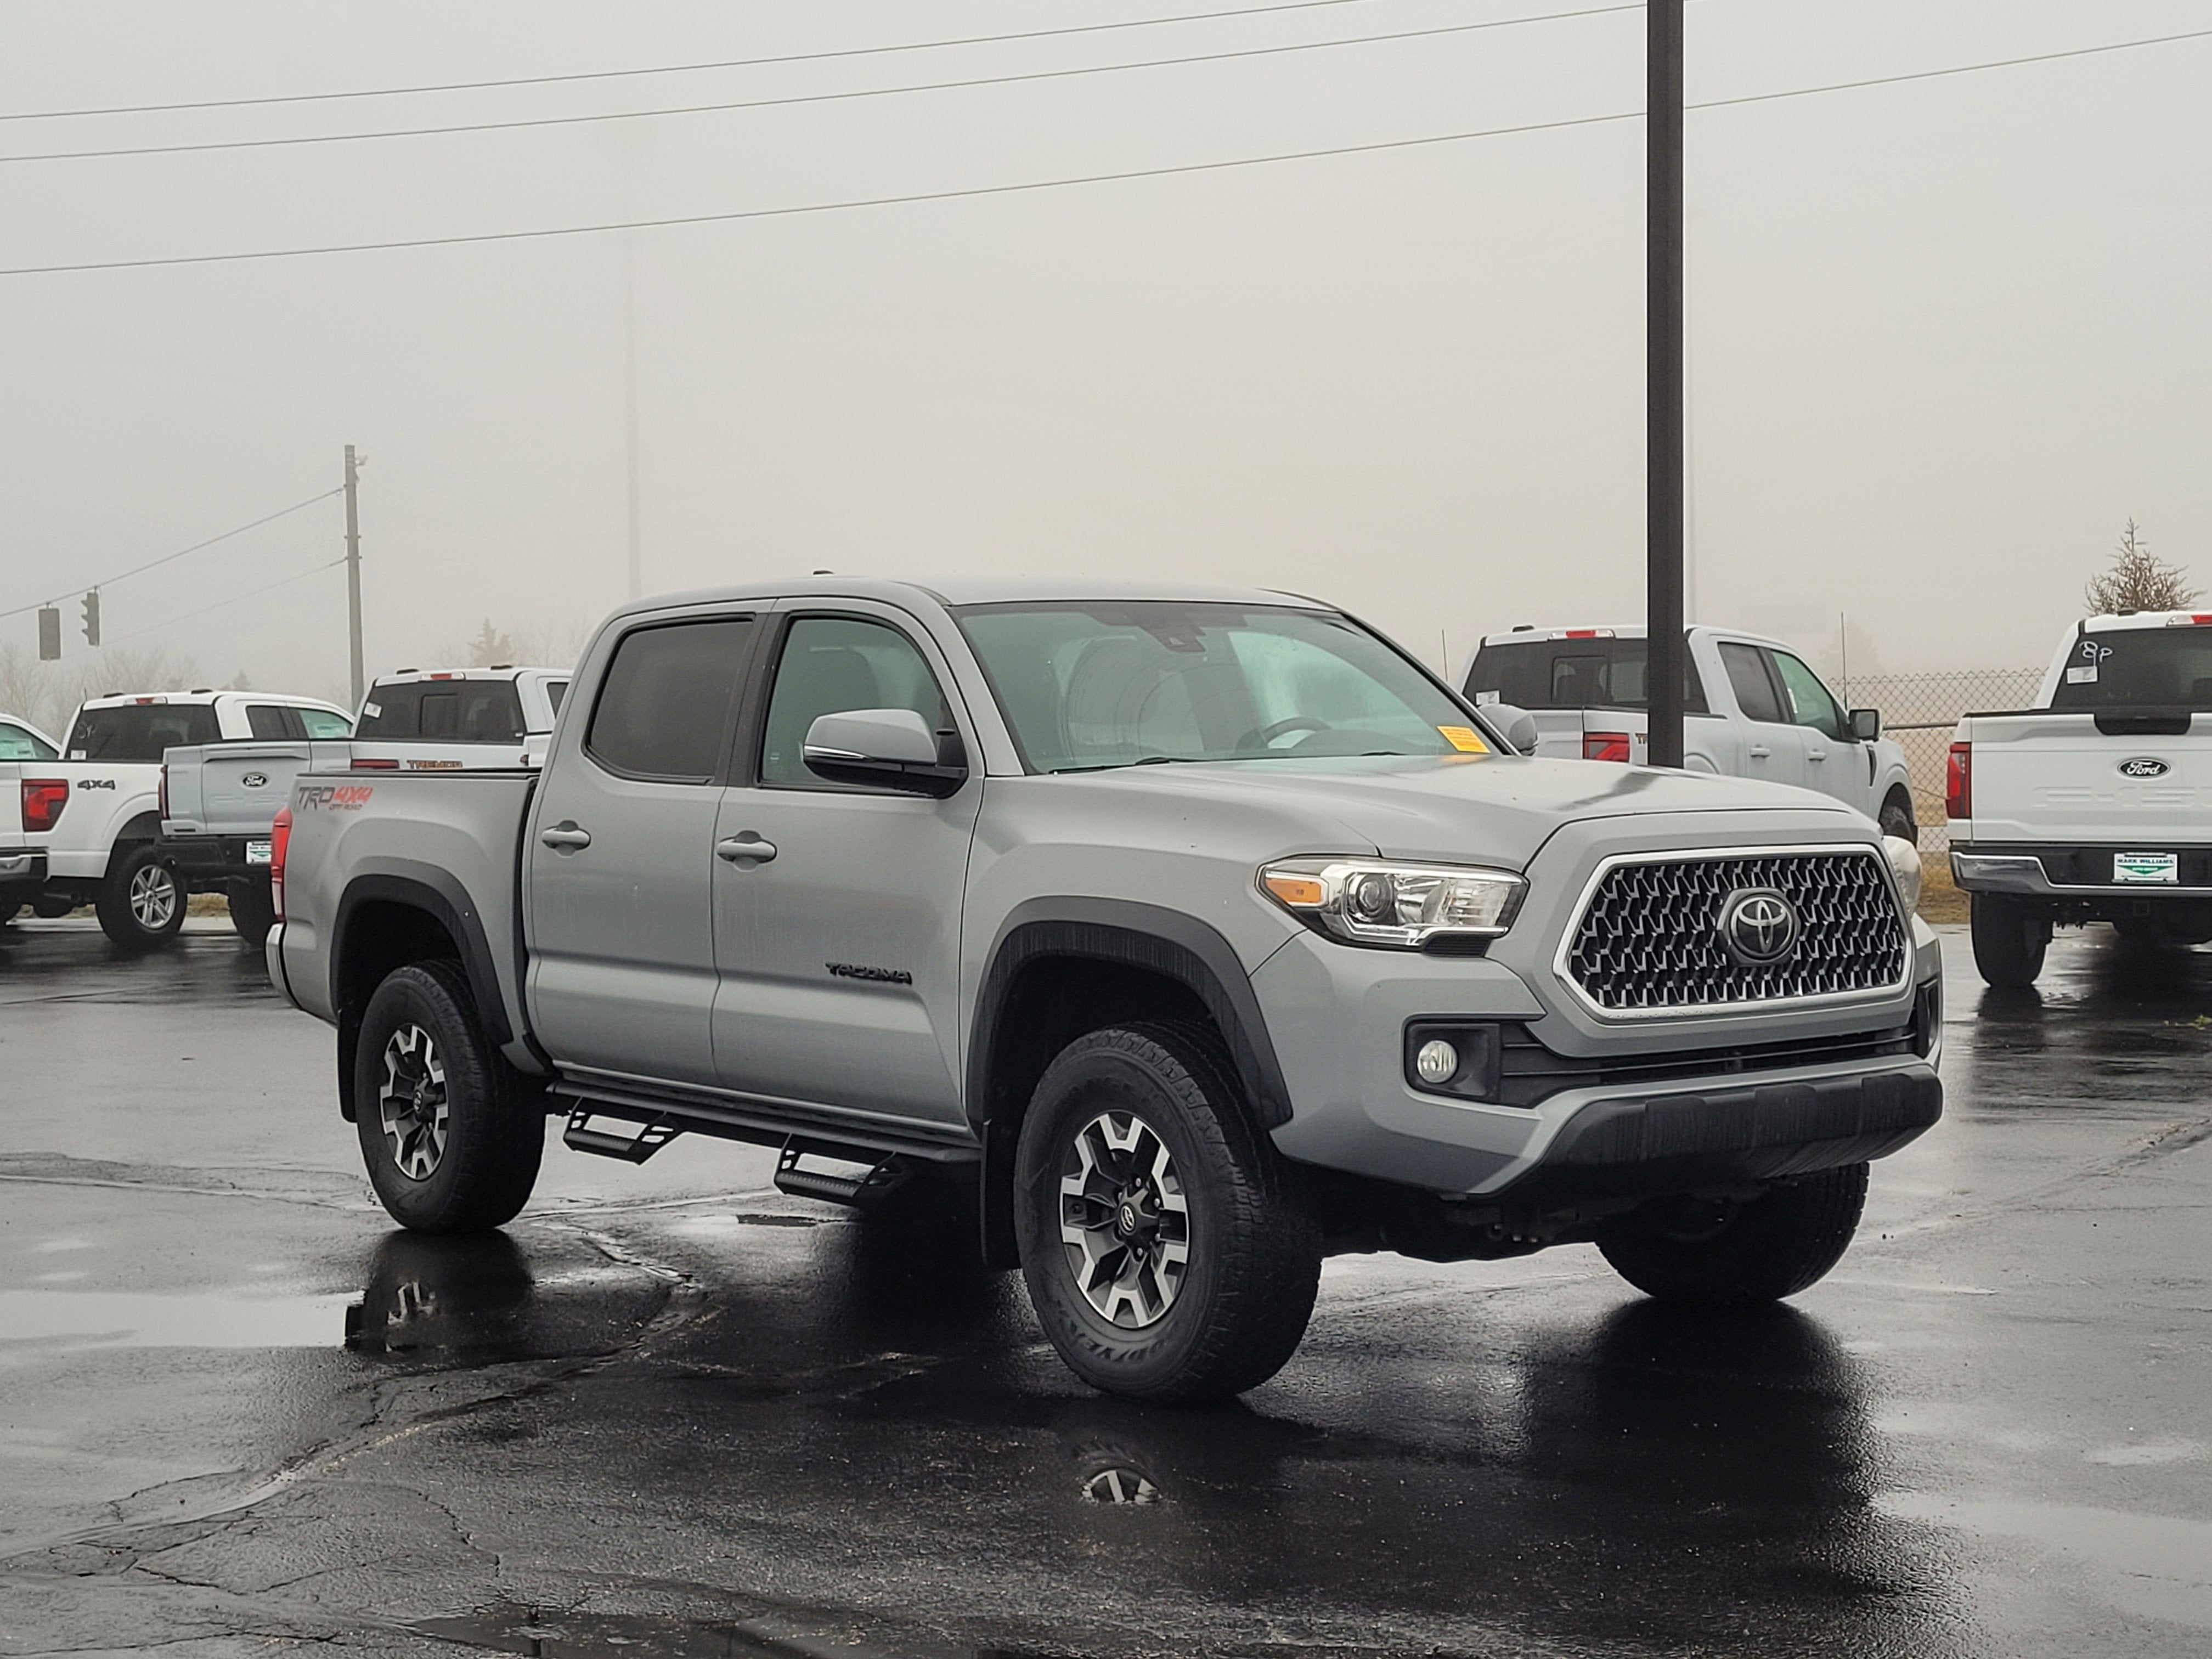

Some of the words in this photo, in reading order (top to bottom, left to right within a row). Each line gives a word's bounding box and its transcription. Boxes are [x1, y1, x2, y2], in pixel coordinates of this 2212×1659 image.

[407, 759, 462, 769] TREMOR
[2126, 760, 2162, 776] Ford
[245, 775, 264, 786] Ford
[298, 786, 336, 810] TRD
[2032, 786, 2212, 807] F-15
[825, 961, 913, 985] TACOMA
